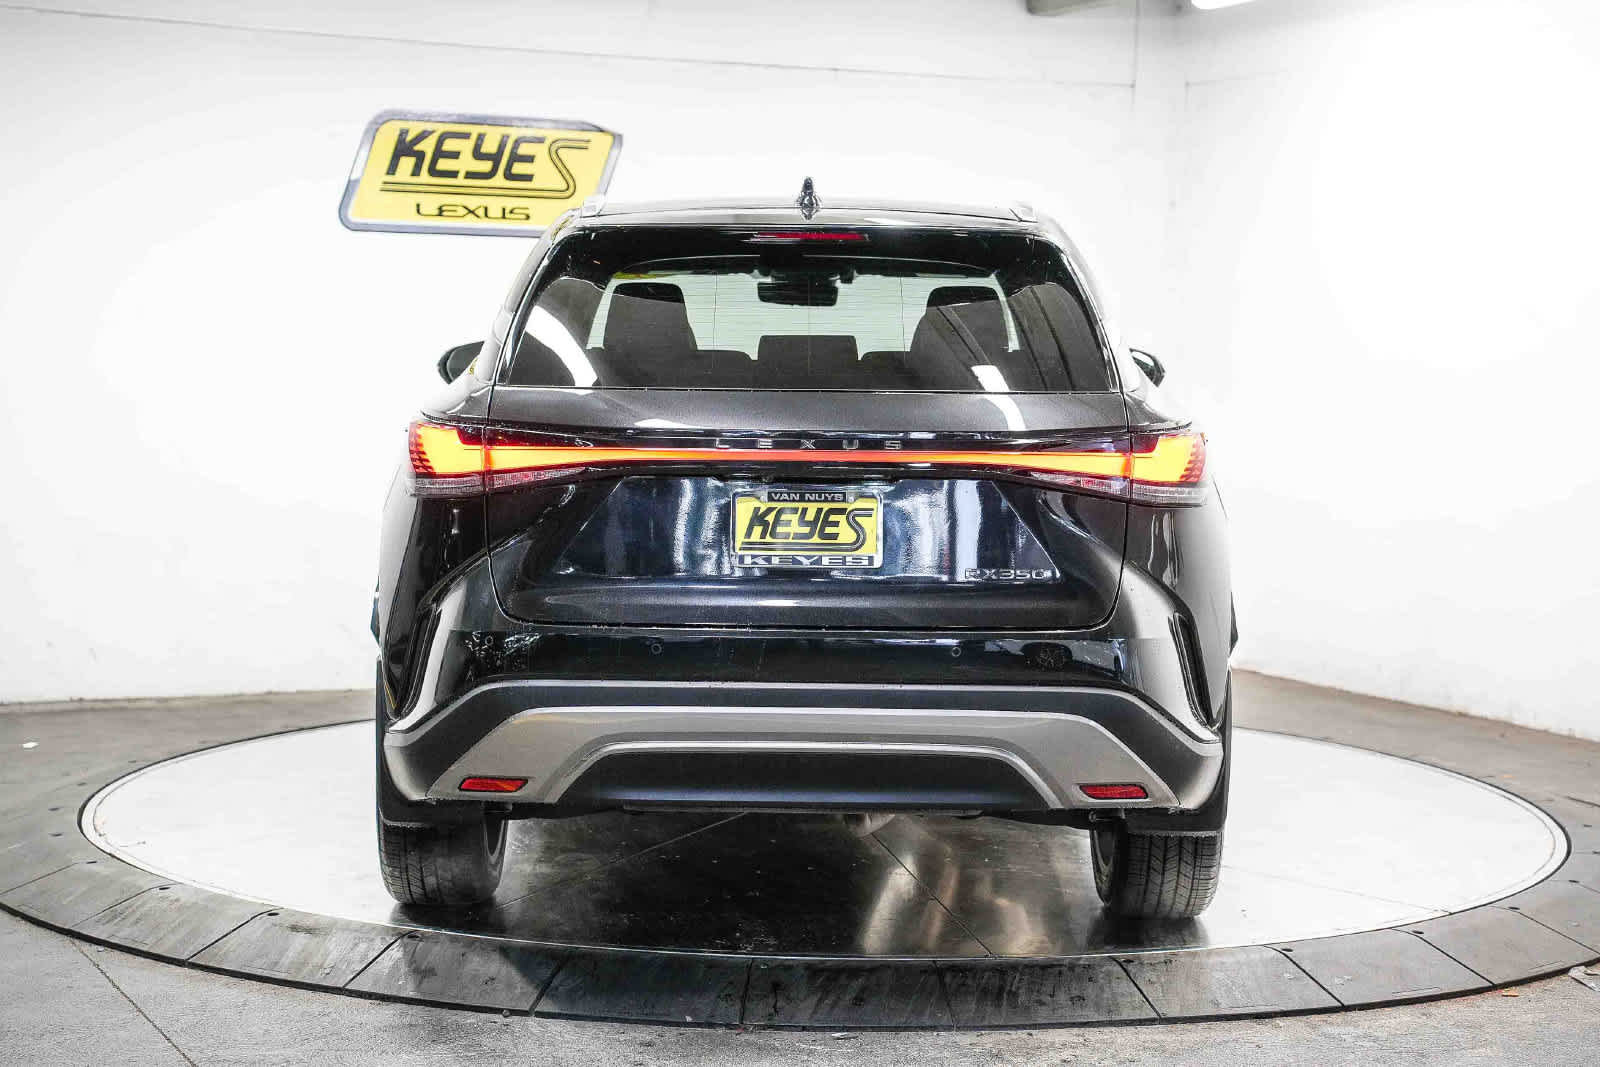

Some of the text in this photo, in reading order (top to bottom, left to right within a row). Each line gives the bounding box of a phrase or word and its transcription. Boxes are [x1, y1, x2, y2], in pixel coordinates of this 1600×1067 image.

[380, 128, 592, 199] KEYES
[416, 203, 530, 221] LEXUS
[715, 438, 901, 450] LEXUS
[771, 492, 844, 501] VAN NUYS
[739, 506, 874, 552] KEYES
[742, 555, 870, 566] KEYES
